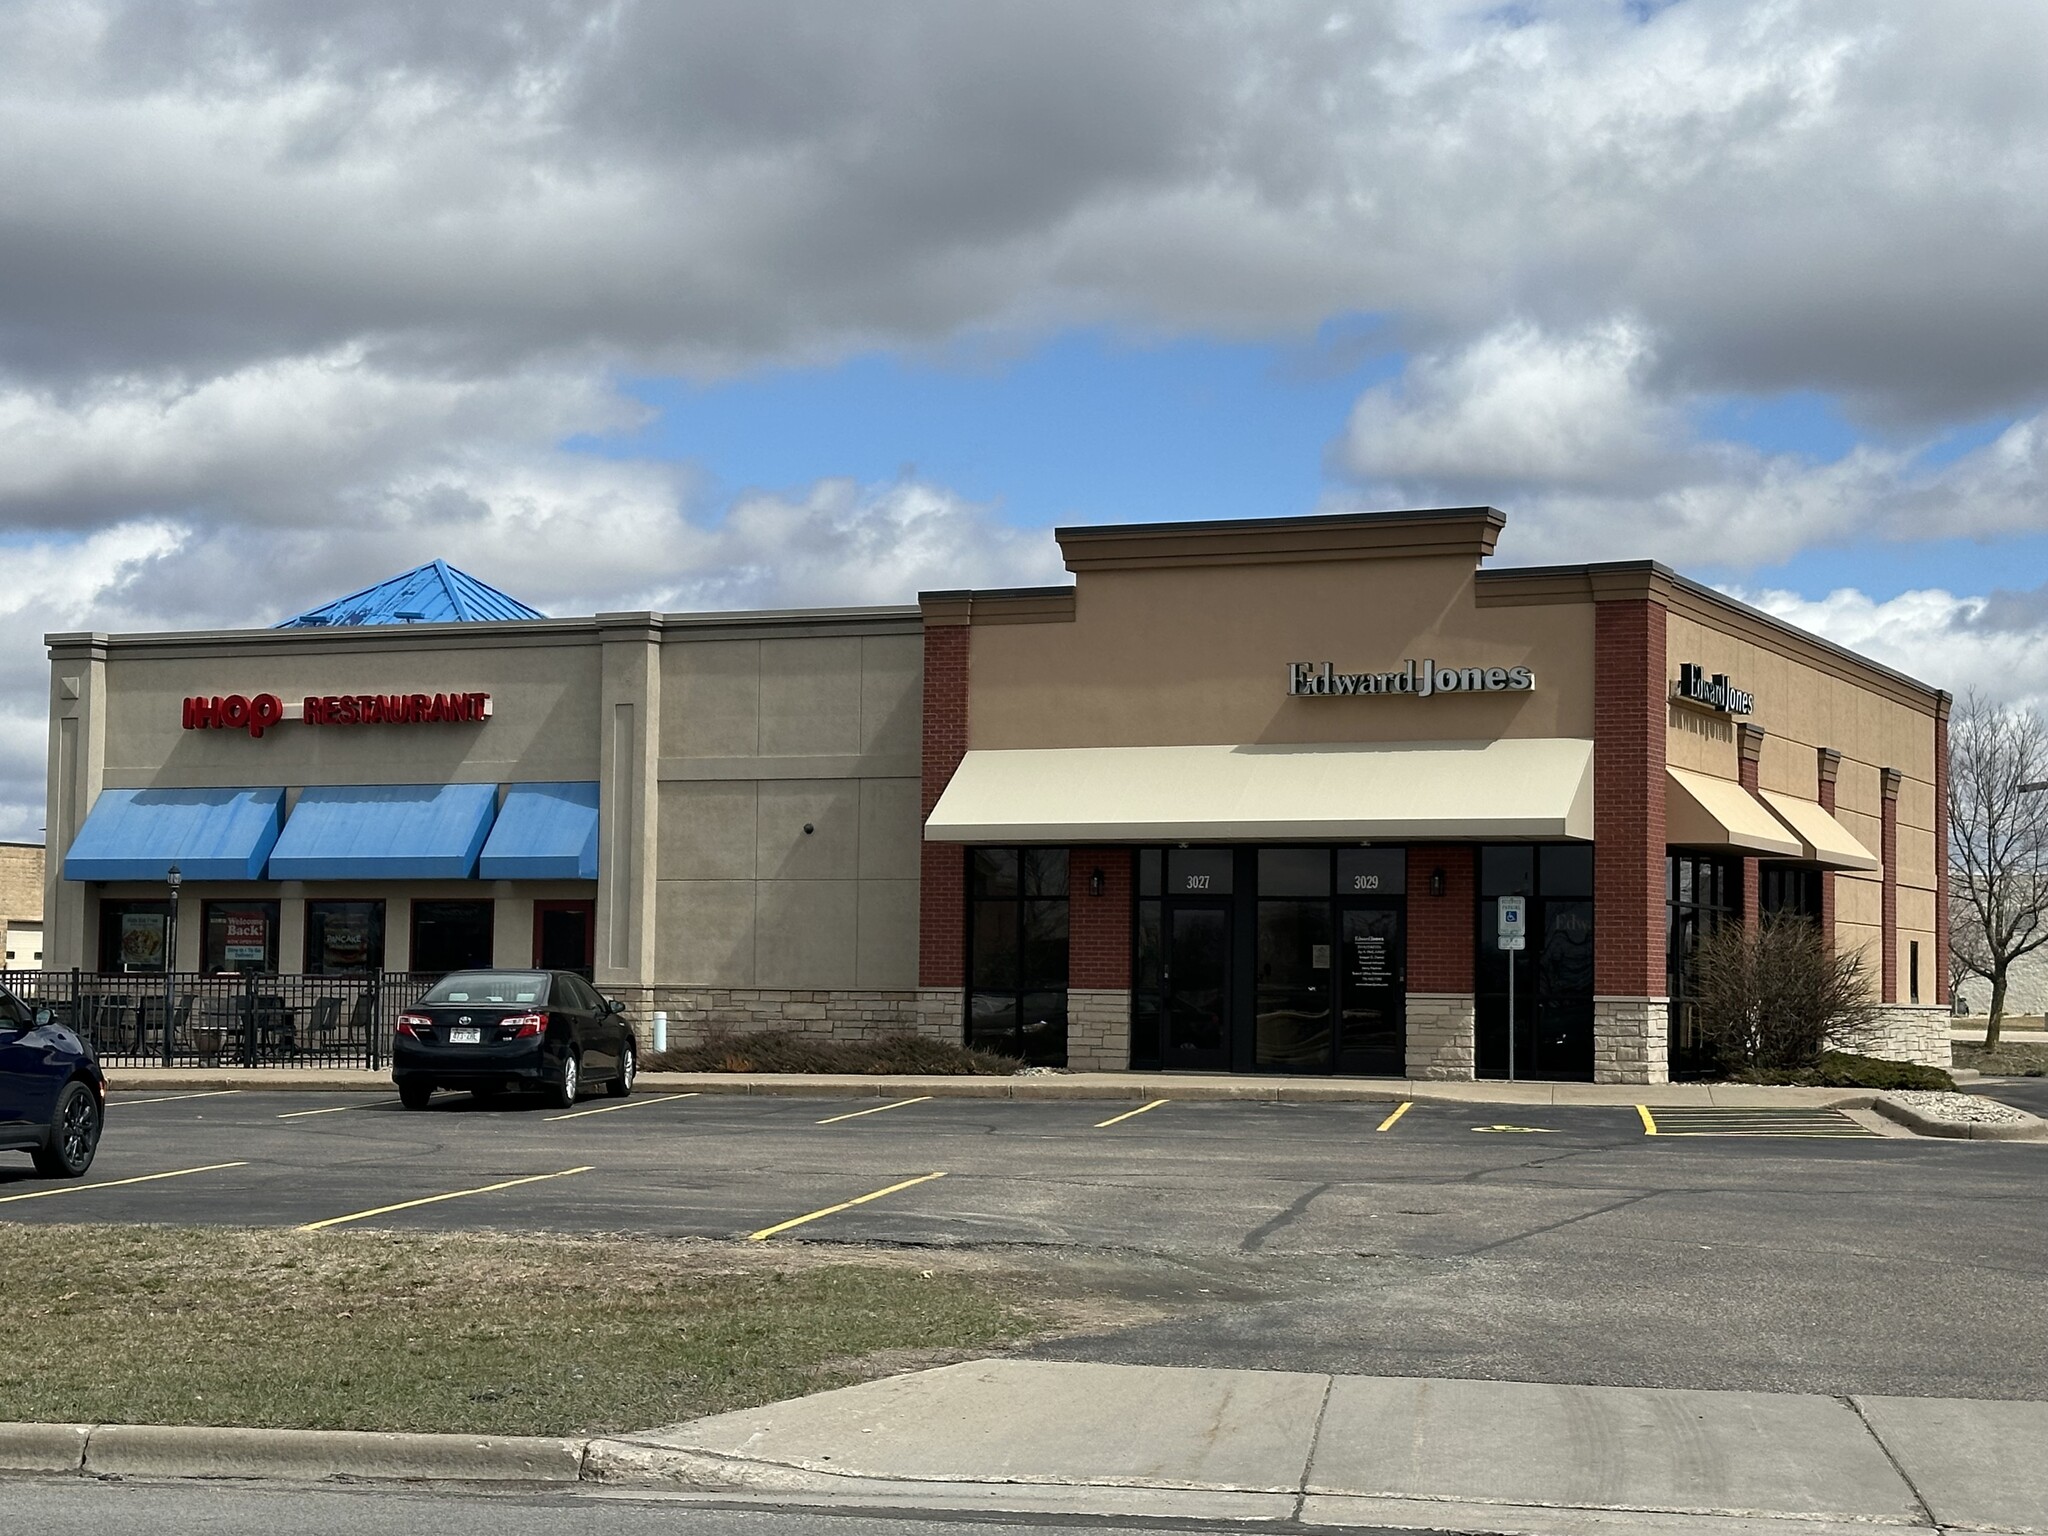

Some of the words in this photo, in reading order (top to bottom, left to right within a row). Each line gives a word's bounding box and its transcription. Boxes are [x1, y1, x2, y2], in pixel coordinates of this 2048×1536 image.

[182, 693, 283, 737] IHOP
[302, 692, 490, 724] RESTAURANT
[1186, 875, 1210, 889] 3027
[1354, 875, 1379, 889] 3029
[227, 917, 264, 926] Welcome
[227, 925, 263, 936] Back!
[326, 932, 362, 943] PANCAKE
